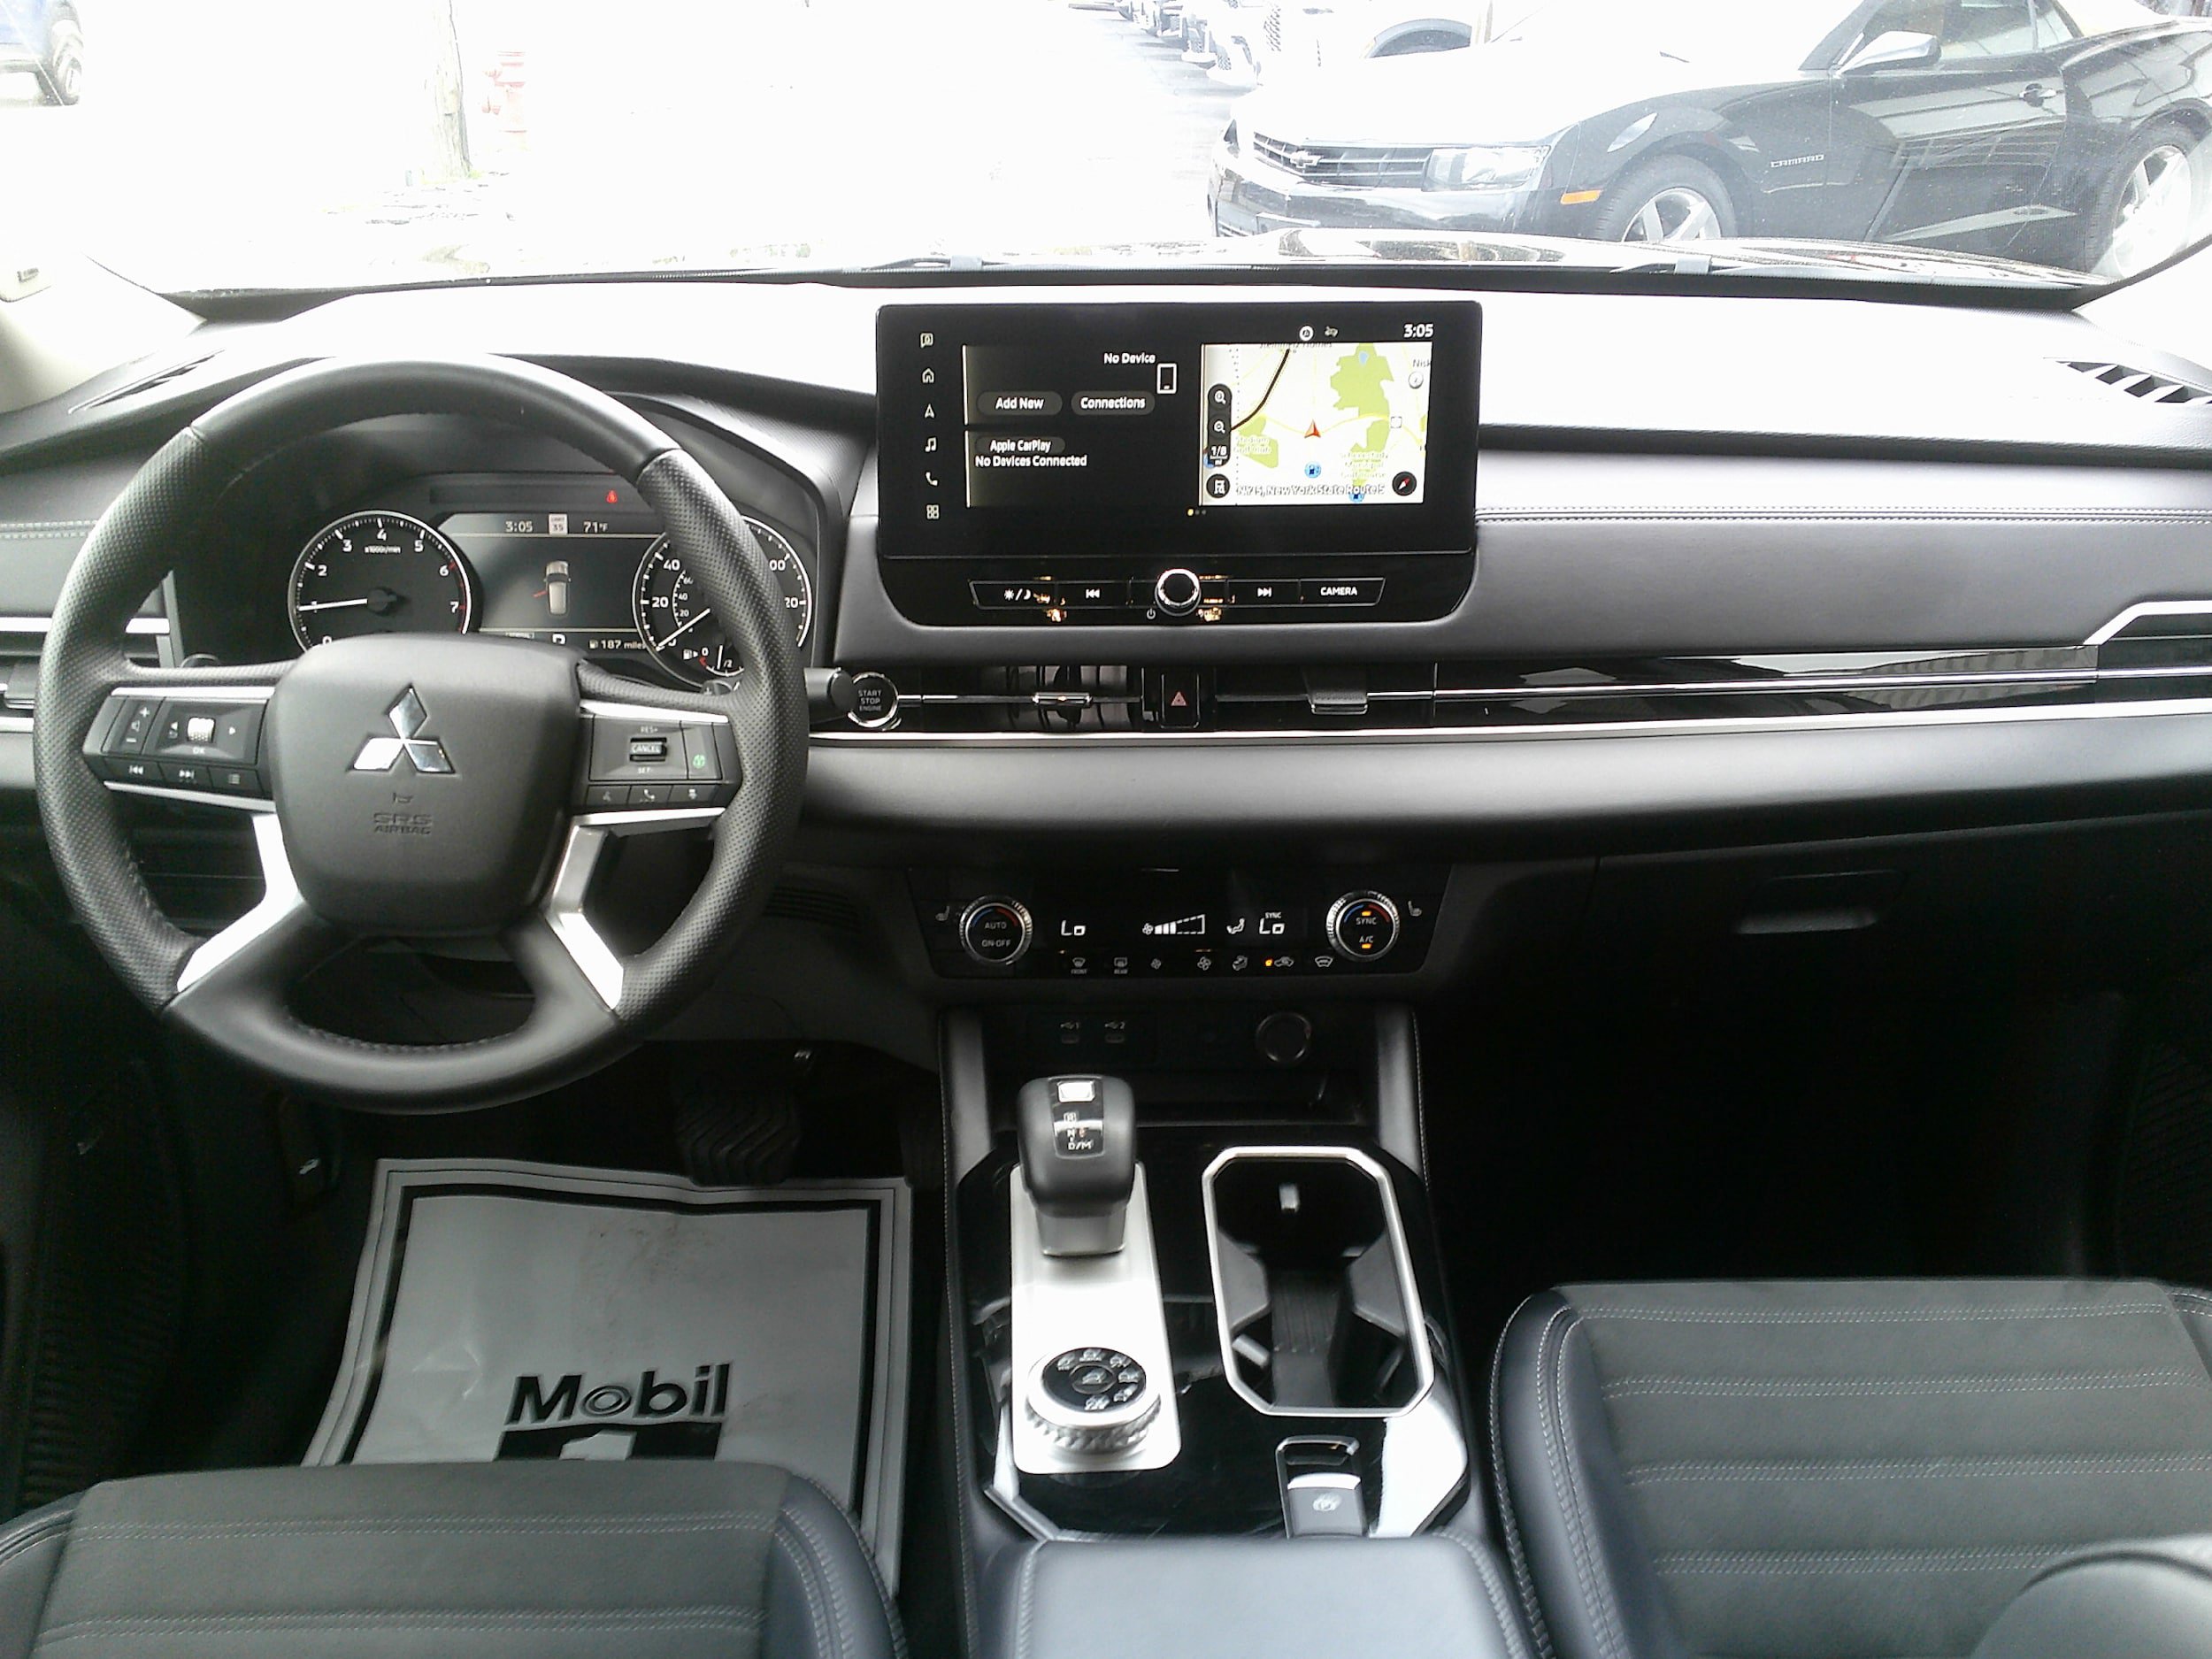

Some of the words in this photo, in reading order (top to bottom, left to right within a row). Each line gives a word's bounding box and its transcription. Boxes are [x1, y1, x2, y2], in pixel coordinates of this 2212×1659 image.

[1770, 154, 1824, 168] CAMARO
[1403, 323, 1433, 338] 3:05
[1103, 352, 1119, 364] No
[1121, 352, 1156, 364] Device
[995, 397, 1018, 410] Add
[1019, 397, 1044, 410] New
[1080, 396, 1146, 410] Connections
[990, 440, 1016, 453] Apple
[1018, 439, 1051, 453] CarPlay
[975, 456, 991, 467] No
[993, 456, 1031, 467] Devices
[1033, 455, 1087, 467] Connected
[505, 520, 534, 533] 3:05
[377, 529, 388, 541] 4
[342, 539, 352, 552] 3
[414, 540, 424, 552] 5
[318, 565, 327, 577] 2
[439, 565, 449, 576] 6
[664, 559, 680, 571] 40
[769, 560, 786, 572] 00
[1320, 586, 1358, 596] CAMERA
[450, 601, 459, 614] 7
[652, 596, 669, 608] 20
[784, 596, 798, 609] 20
[601, 640, 621, 649] 187
[631, 744, 661, 753] CANCEL
[373, 825, 432, 834] AIRBAG
[503, 1362, 731, 1426] Mobil
